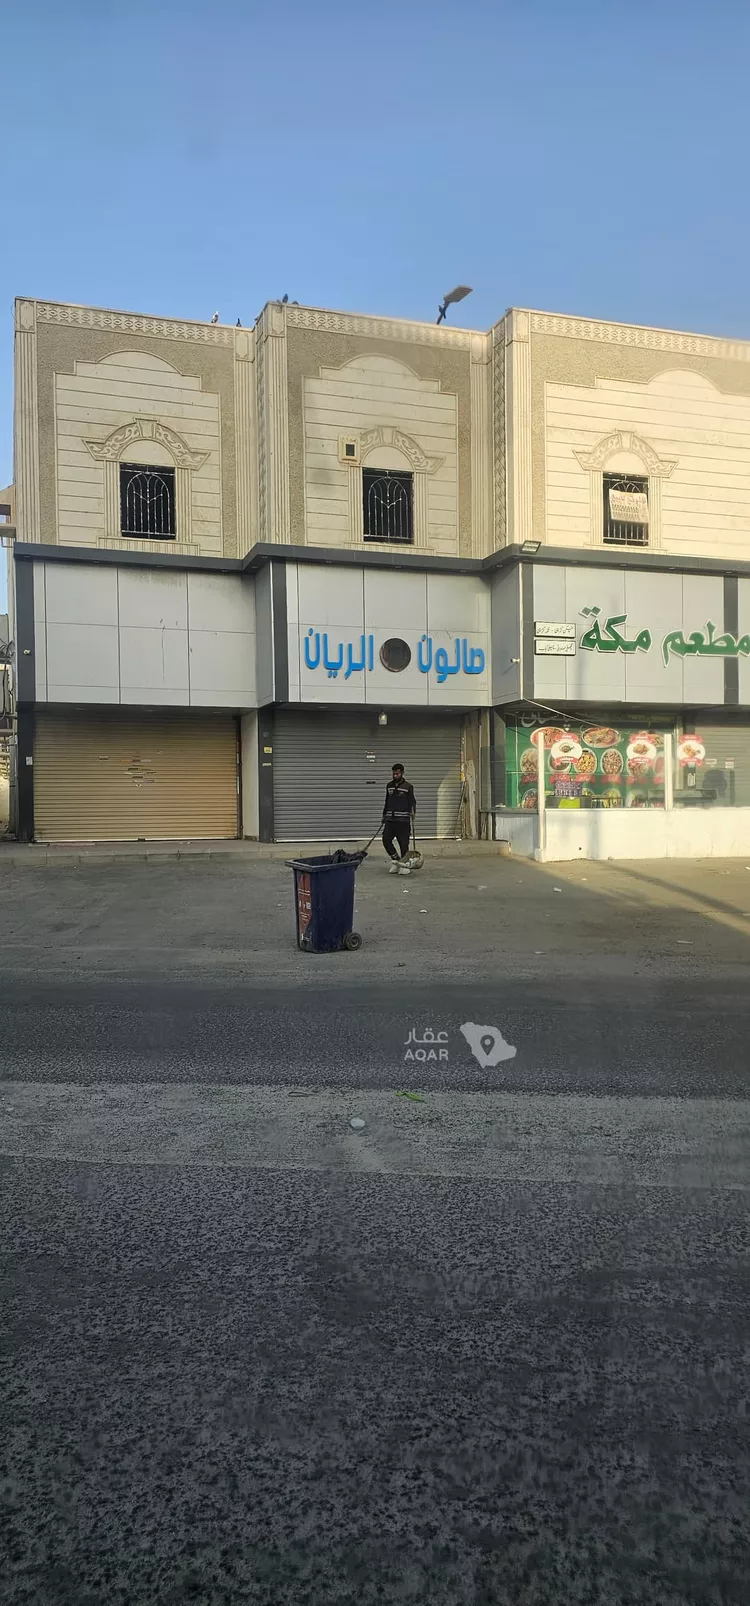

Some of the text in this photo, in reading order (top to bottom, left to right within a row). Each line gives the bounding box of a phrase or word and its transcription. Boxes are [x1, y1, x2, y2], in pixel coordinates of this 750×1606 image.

[304, 627, 486, 683] صالون الريان
[579, 605, 750, 667] مطعم مكة
